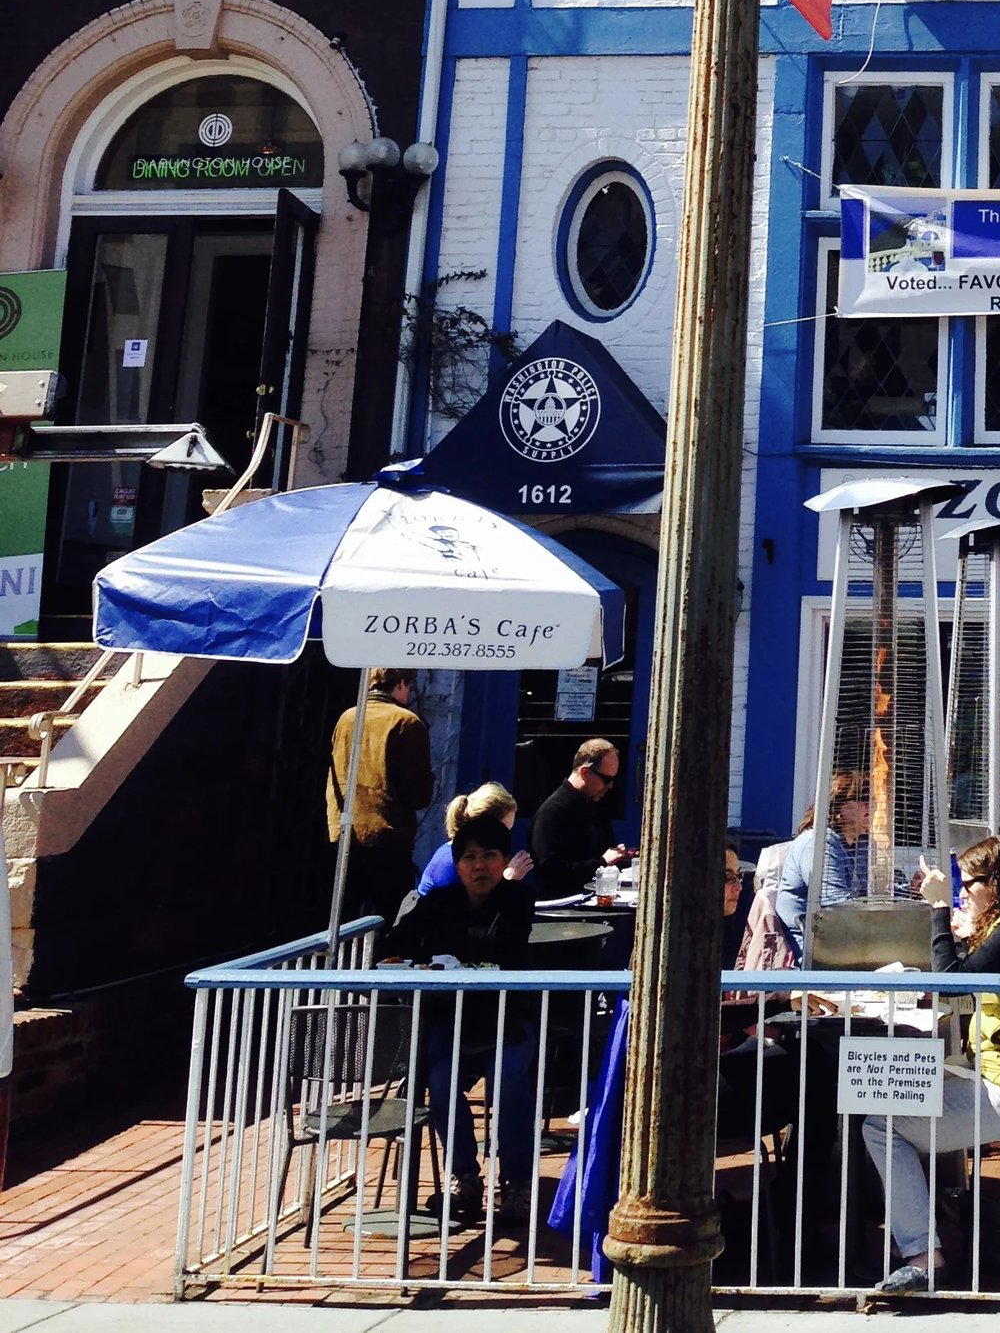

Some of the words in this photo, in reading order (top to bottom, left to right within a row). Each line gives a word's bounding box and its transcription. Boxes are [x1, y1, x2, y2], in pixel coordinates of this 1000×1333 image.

[132, 161, 190, 178] DINING
[197, 161, 250, 177] ROOM
[258, 159, 306, 176] OPEN
[242, 156, 292, 168] HOUSE
[886, 275, 952, 290] Voted...
[12, 350, 54, 361] HOUSE
[503, 360, 565, 403] WASHINGTON
[571, 368, 598, 400] POLICE
[522, 446, 575, 459] SUPPLY
[518, 485, 572, 504] 1612
[364, 615, 481, 635] ZORBA'S
[407, 642, 516, 659] 202.387.8555
[848, 1051, 887, 1062] Bicycles
[893, 1053, 909, 1062] and
[914, 1054, 936, 1063] Pets
[867, 1065, 884, 1073] Not
[889, 1065, 936, 1075] Permitted
[868, 1077, 883, 1086] the
[888, 1078, 931, 1087] Premises
[873, 1090, 888, 1099] the
[893, 1091, 925, 1102] Railing
